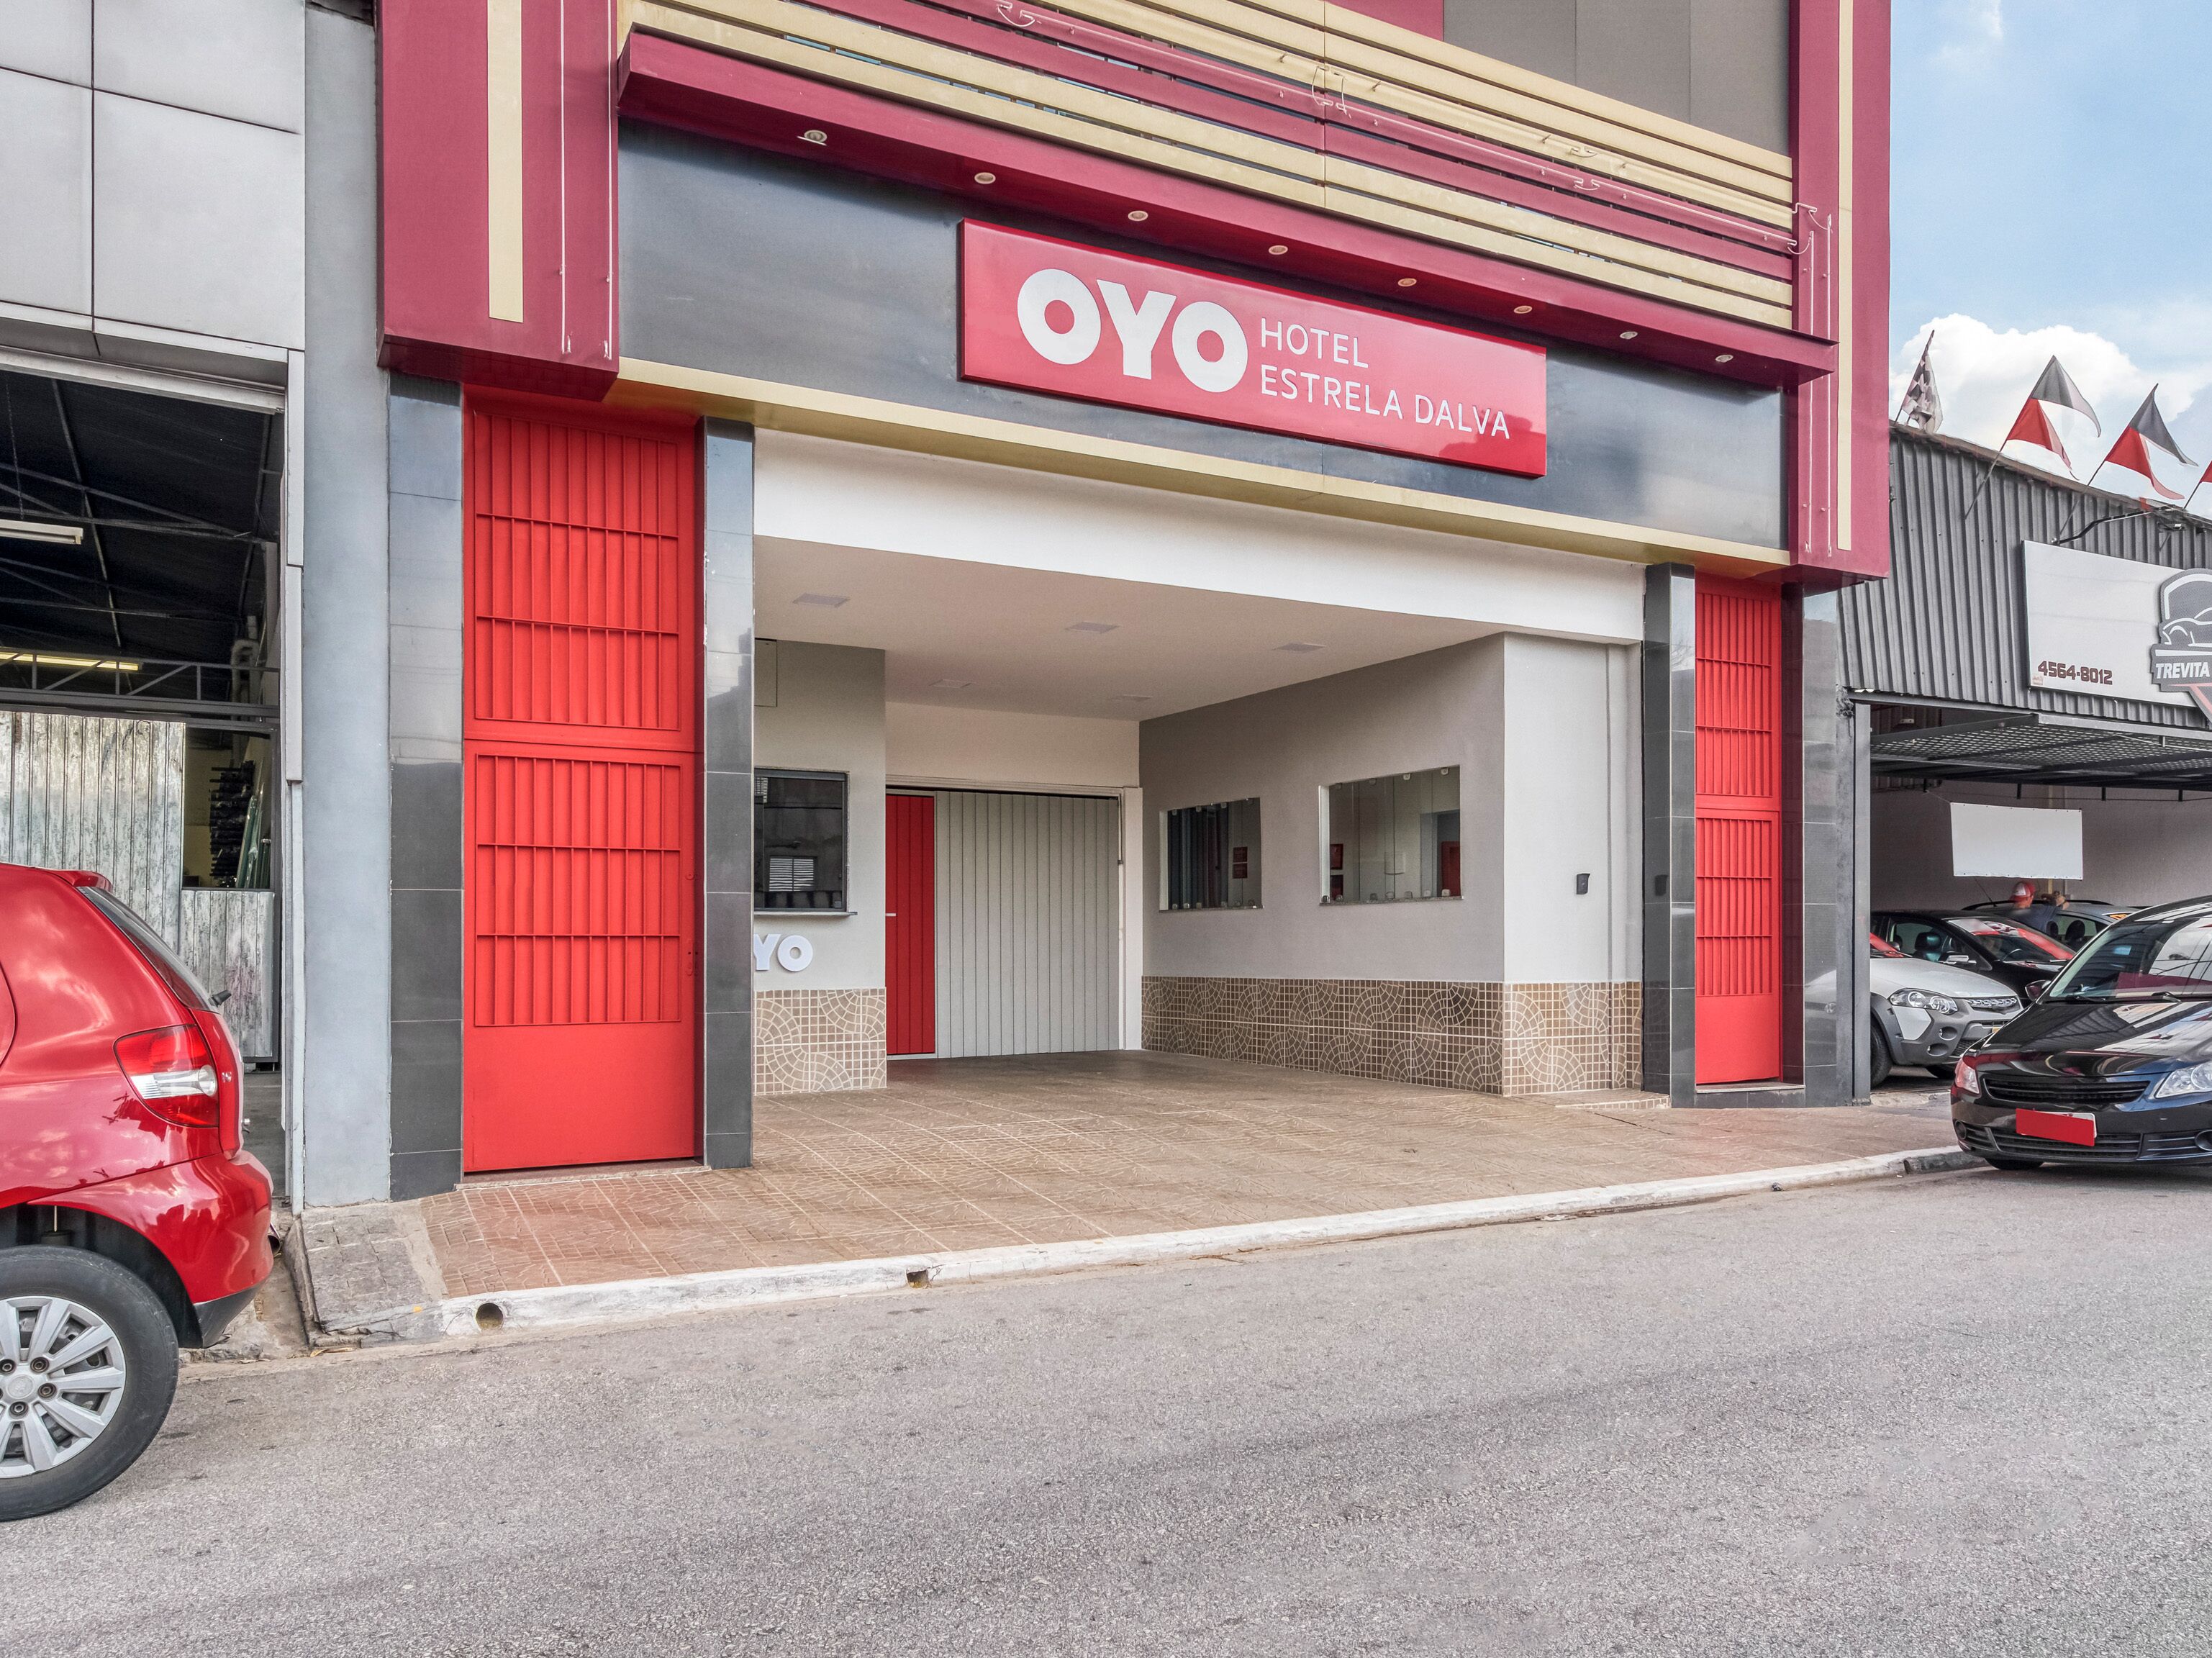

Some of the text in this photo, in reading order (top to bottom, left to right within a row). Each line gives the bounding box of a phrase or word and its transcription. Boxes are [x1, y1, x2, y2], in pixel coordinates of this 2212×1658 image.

[1017, 268, 1248, 393] OYO
[1261, 317, 1369, 369] HOTEL
[1261, 363, 1510, 440] ESTRELA DALVA
[2037, 660, 2113, 686] 4564-8012
[2155, 661, 2211, 679] TREVITA
